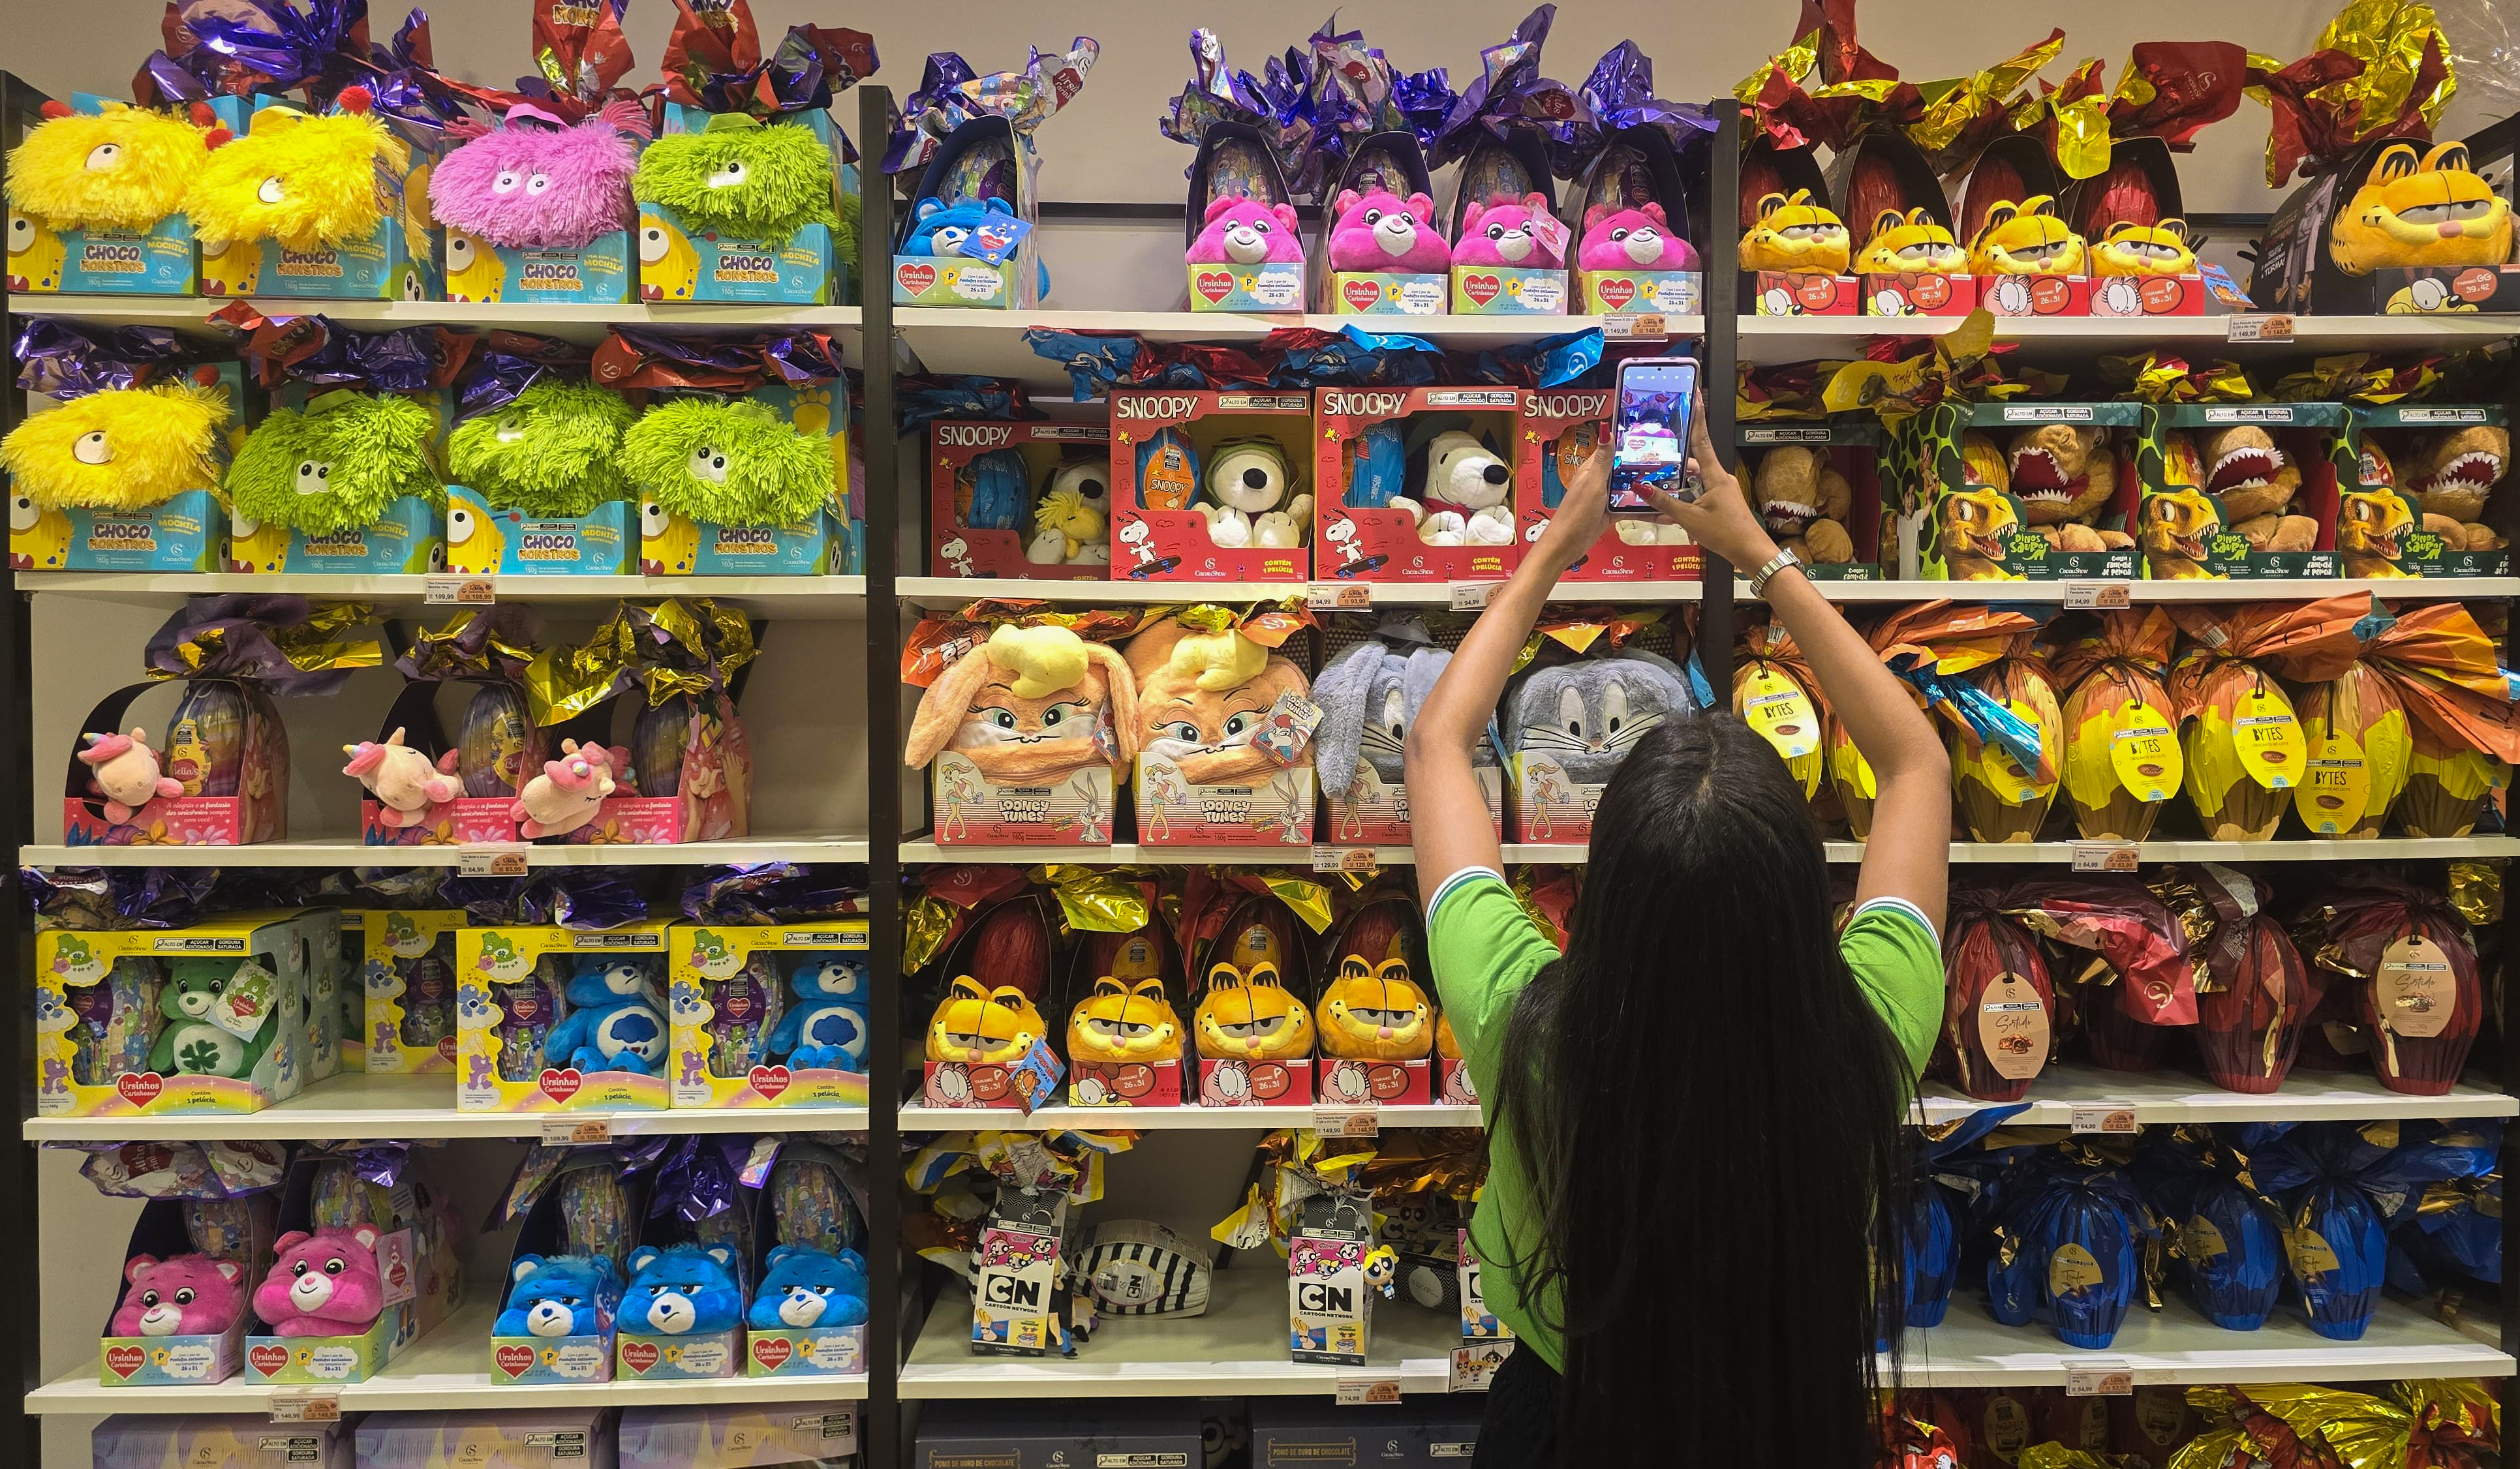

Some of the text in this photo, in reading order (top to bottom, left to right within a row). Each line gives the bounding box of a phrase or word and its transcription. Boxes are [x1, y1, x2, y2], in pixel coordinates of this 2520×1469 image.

[85, 245, 141, 261] CHOCO
[147, 242, 189, 254] MOCHILA
[282, 249, 337, 264] CHOCO
[780, 252, 820, 265] MOCHILA
[81, 261, 146, 273] MONSTROS
[585, 259, 624, 272] MOCHILA
[720, 255, 773, 271] CHOCO
[277, 264, 343, 277] MONSTROS
[525, 264, 577, 279] CHOCO
[715, 271, 778, 282] MONSTROS
[900, 270, 933, 280] Ursinhos
[1200, 279, 1231, 288] Ursinhos
[2477, 273, 2492, 283] GG
[521, 279, 583, 290] MONSTROS
[1466, 280, 1498, 290] Ursinhos
[1601, 285, 1632, 294] Ursinhos
[1822, 279, 1829, 290] P
[2166, 281, 2175, 293] P
[1116, 396, 1199, 419] SNOOPY
[1323, 393, 1406, 416] SNOOPY
[1524, 395, 1606, 417] SNOOPY
[939, 426, 1012, 446] SNOOPY
[1150, 479, 1188, 493] SNOOPY
[94, 524, 151, 538] CHOCO
[158, 519, 200, 532] MOCHILA
[581, 530, 620, 541] MOCHILA
[719, 529, 771, 543] CHOCO
[89, 538, 157, 550] MONSTROS
[523, 536, 574, 549] CHOCO
[715, 543, 777, 554] MONSTROS
[305, 544, 367, 556] MONSTROS
[519, 549, 580, 560] MONSTROS
[1267, 566, 1293, 574] PELÚCIA
[1764, 703, 1794, 718] BYTES
[2252, 727, 2283, 741] BYTES
[2130, 739, 2160, 755] BYTES
[2315, 771, 2346, 785] BYTES
[998, 799, 1050, 811] LOONEY
[1200, 800, 1252, 813] LOONEY
[1002, 810, 1046, 823] TUNES
[1204, 811, 1246, 824] TUNES
[2395, 974, 2436, 991] Sortido
[1995, 1015, 2032, 1033] Sortido
[752, 1074, 788, 1083] Ursinhos
[994, 1069, 1002, 1080] P
[121, 1081, 159, 1091] Ursinhos
[542, 1077, 578, 1086] Ursinhos
[987, 1273, 1040, 1306] CN
[1299, 1282, 1352, 1312] CN
[985, 1302, 1011, 1310] CARTOON
[755, 1345, 790, 1354] Ursinhos
[109, 1354, 142, 1363] Ursinhos
[253, 1353, 286, 1362] Ursinhos
[499, 1354, 532, 1362] Ursinhos
